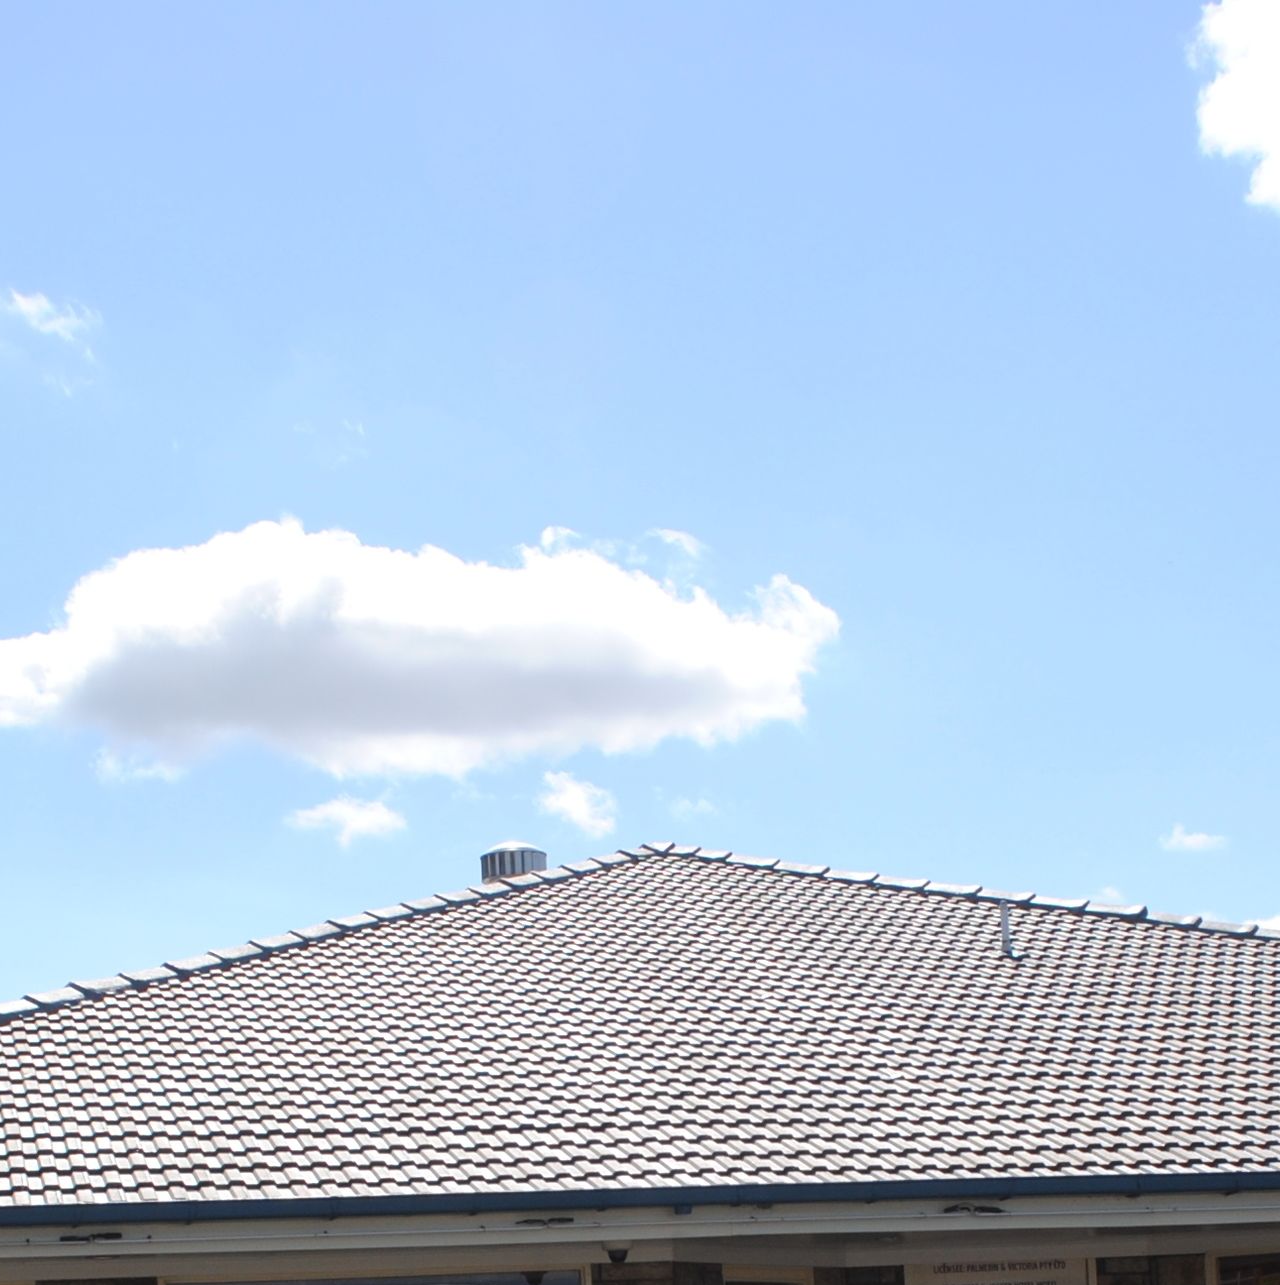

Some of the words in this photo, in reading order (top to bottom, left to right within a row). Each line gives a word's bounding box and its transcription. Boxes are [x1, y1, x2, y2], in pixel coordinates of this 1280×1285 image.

[1007, 1261, 1038, 1272] VICTORIA
[1039, 1260, 1052, 1270] PTY
[1053, 1259, 1066, 1270] LTD
